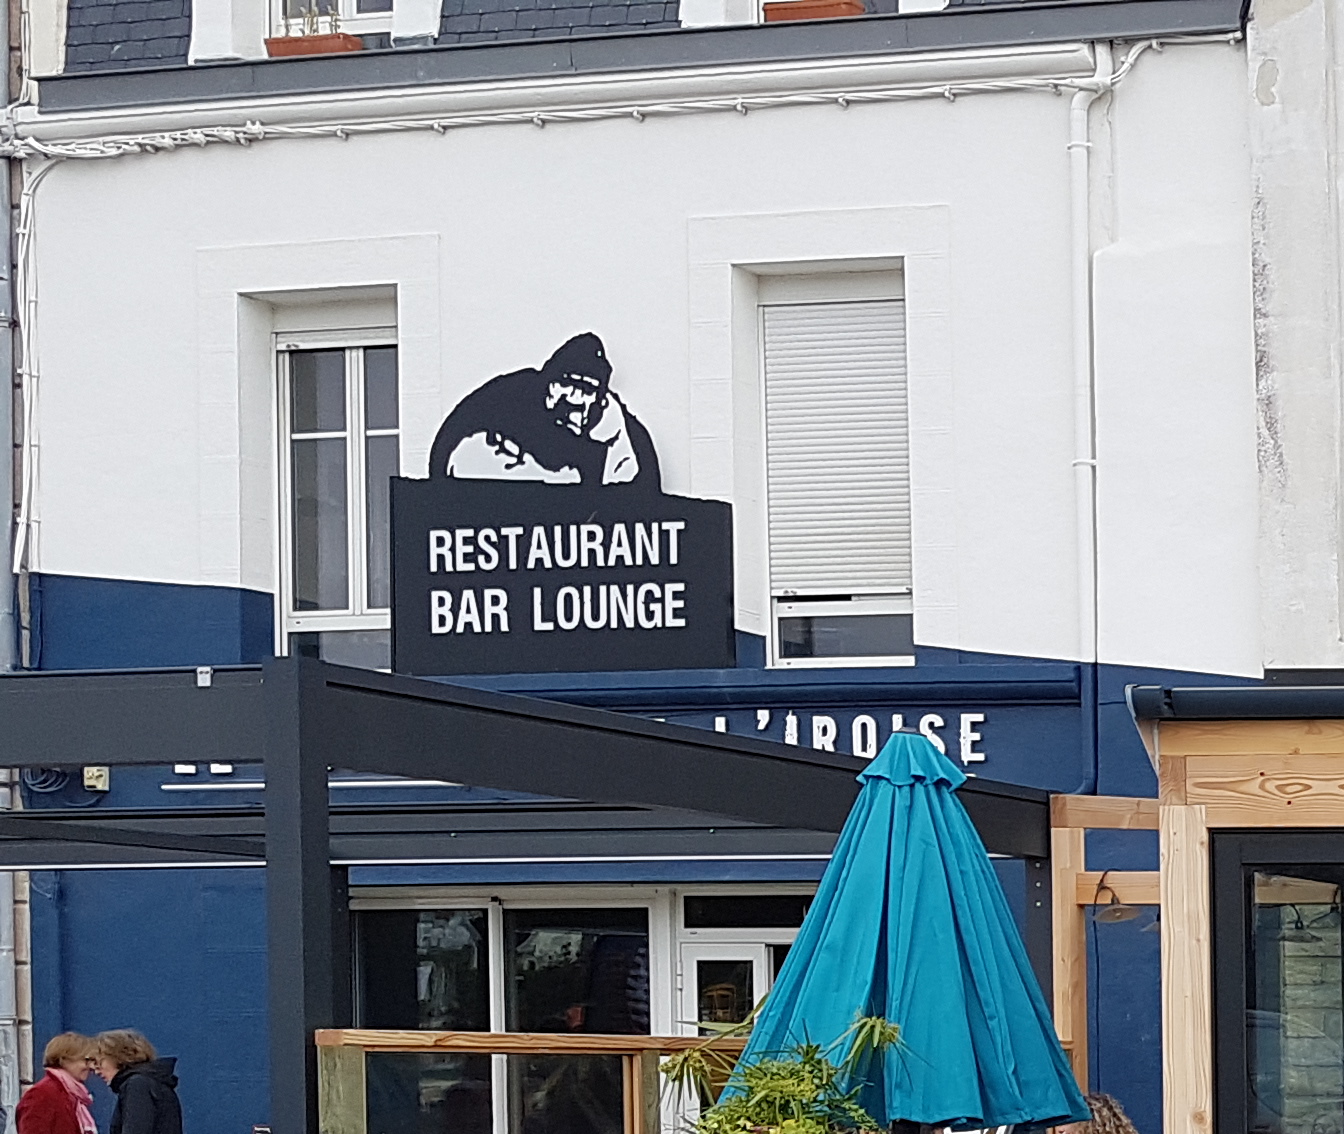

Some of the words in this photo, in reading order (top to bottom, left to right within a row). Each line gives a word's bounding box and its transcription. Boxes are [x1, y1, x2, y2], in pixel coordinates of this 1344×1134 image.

[429, 521, 686, 573] RESTAURANT
[430, 588, 510, 634] BAR
[533, 582, 686, 632] LOUNGE
